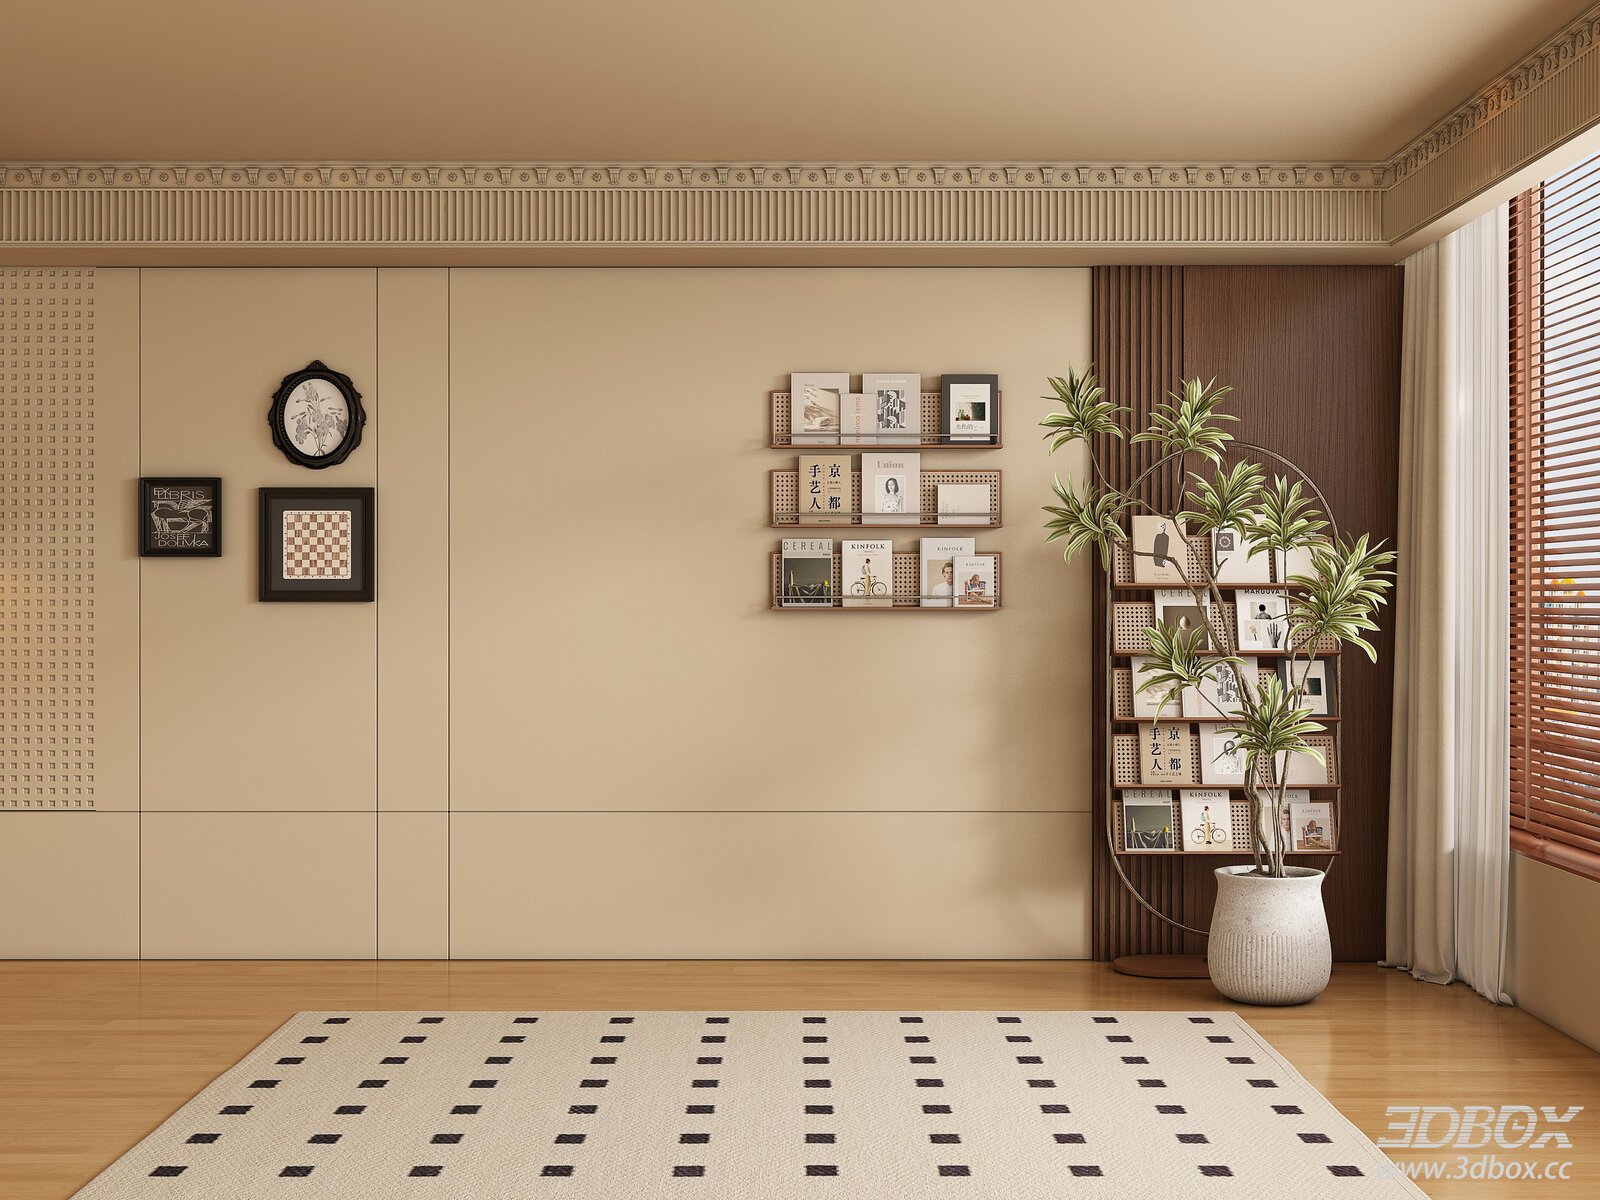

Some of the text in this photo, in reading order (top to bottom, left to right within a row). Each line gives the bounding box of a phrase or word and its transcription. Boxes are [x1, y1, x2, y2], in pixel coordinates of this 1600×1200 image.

[877, 460, 904, 469] Union
[809, 464, 821, 510] 手艺人
[783, 541, 832, 551] CEREAL
[1149, 727, 1163, 771] 手艺人
[1124, 790, 1171, 799] CEREAL
